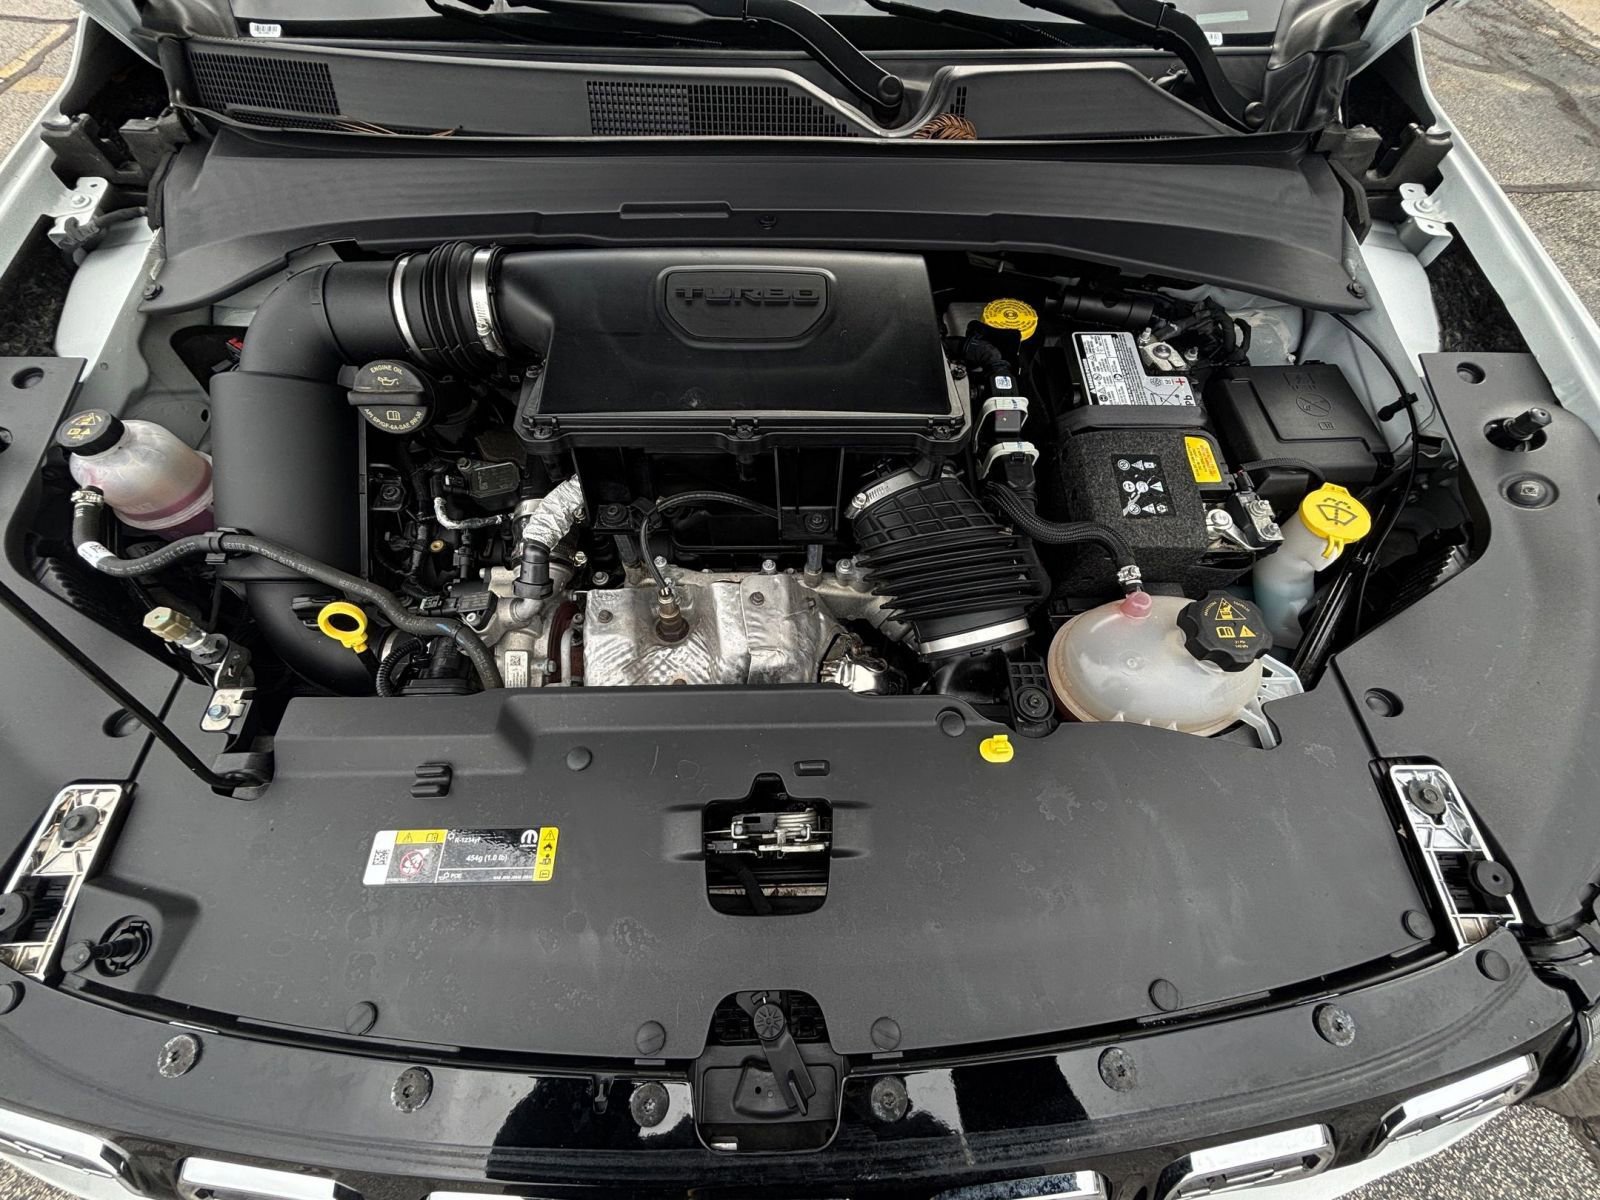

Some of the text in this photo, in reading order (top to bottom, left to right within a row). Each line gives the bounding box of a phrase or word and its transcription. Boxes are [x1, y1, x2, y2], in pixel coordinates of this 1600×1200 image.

[674, 287, 820, 307] TURBO
[370, 364, 403, 375] ENGINE OIL
[1185, 394, 1194, 406] Pb
[454, 836, 481, 845] R-1234yf
[465, 854, 483, 863] 454g
